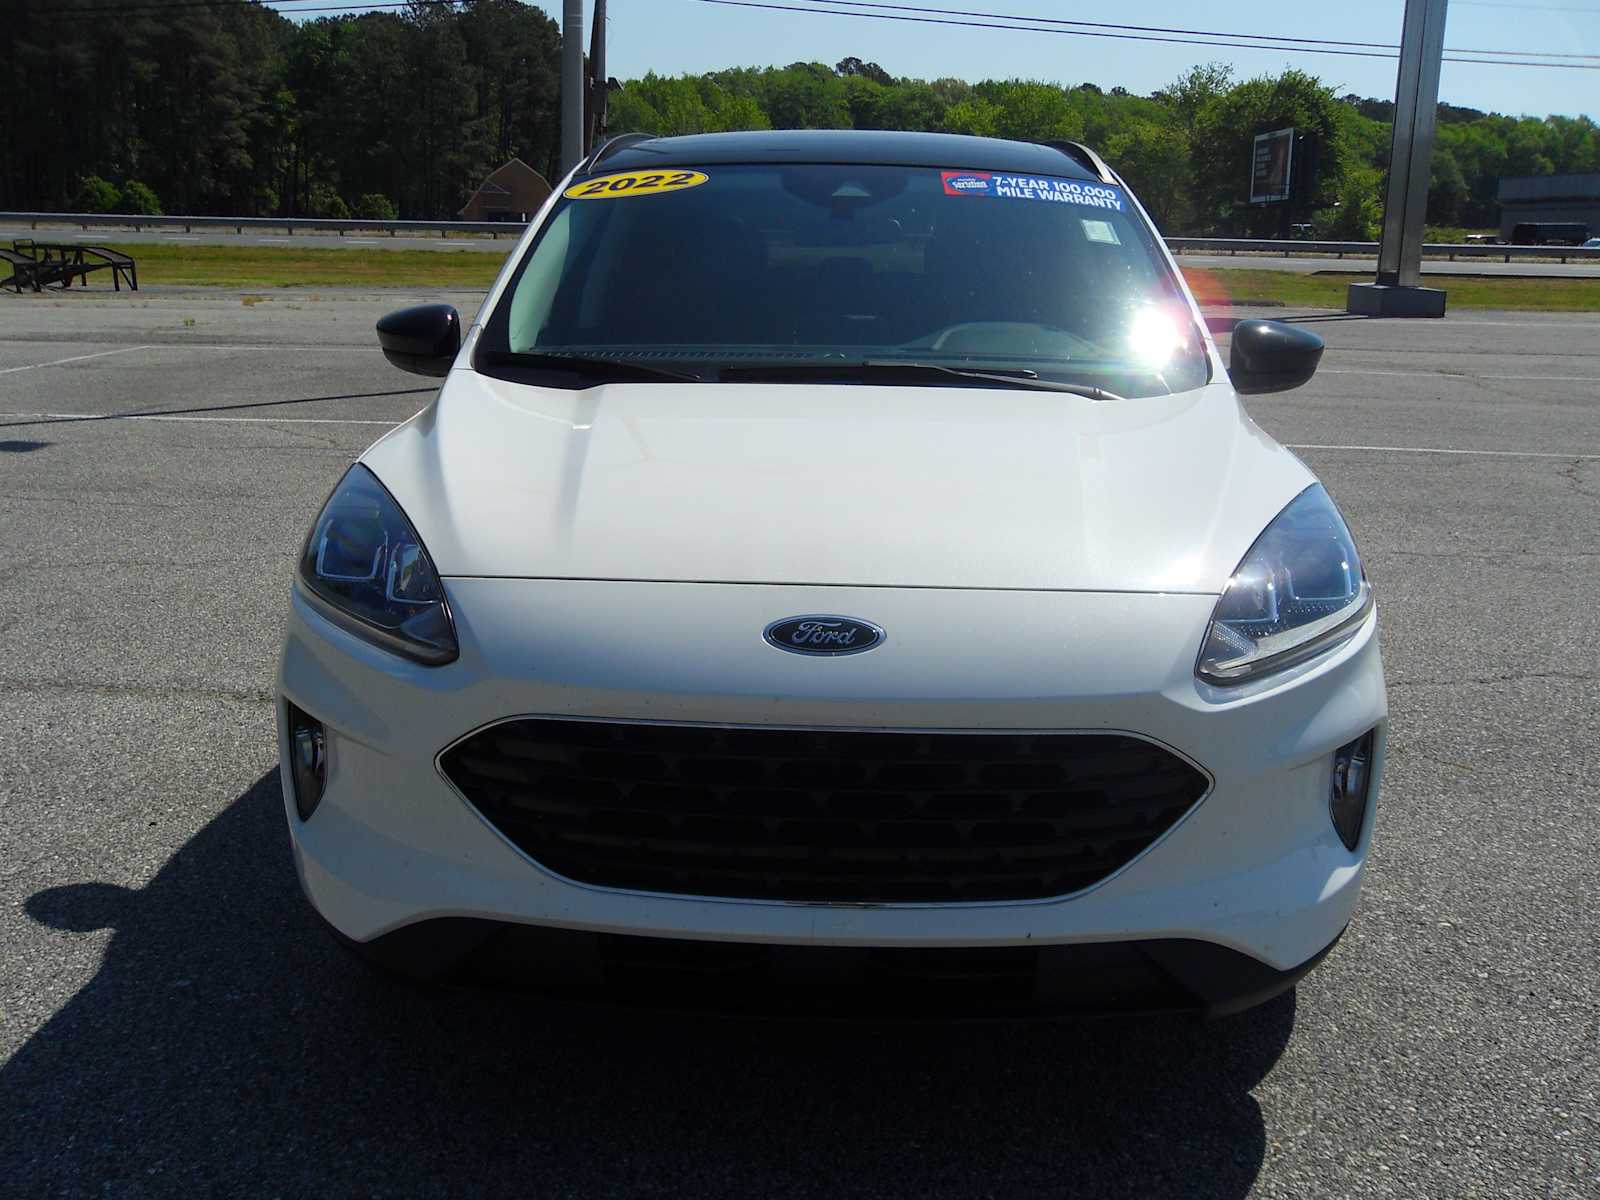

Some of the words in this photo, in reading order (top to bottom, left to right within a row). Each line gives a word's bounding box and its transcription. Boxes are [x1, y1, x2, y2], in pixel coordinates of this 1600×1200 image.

[578, 174, 695, 196] 2022
[993, 176, 1050, 190] 7-YEAR
[997, 187, 1035, 199] MILE
[1039, 189, 1121, 211] WARRANTY
[791, 621, 857, 645] Ford
